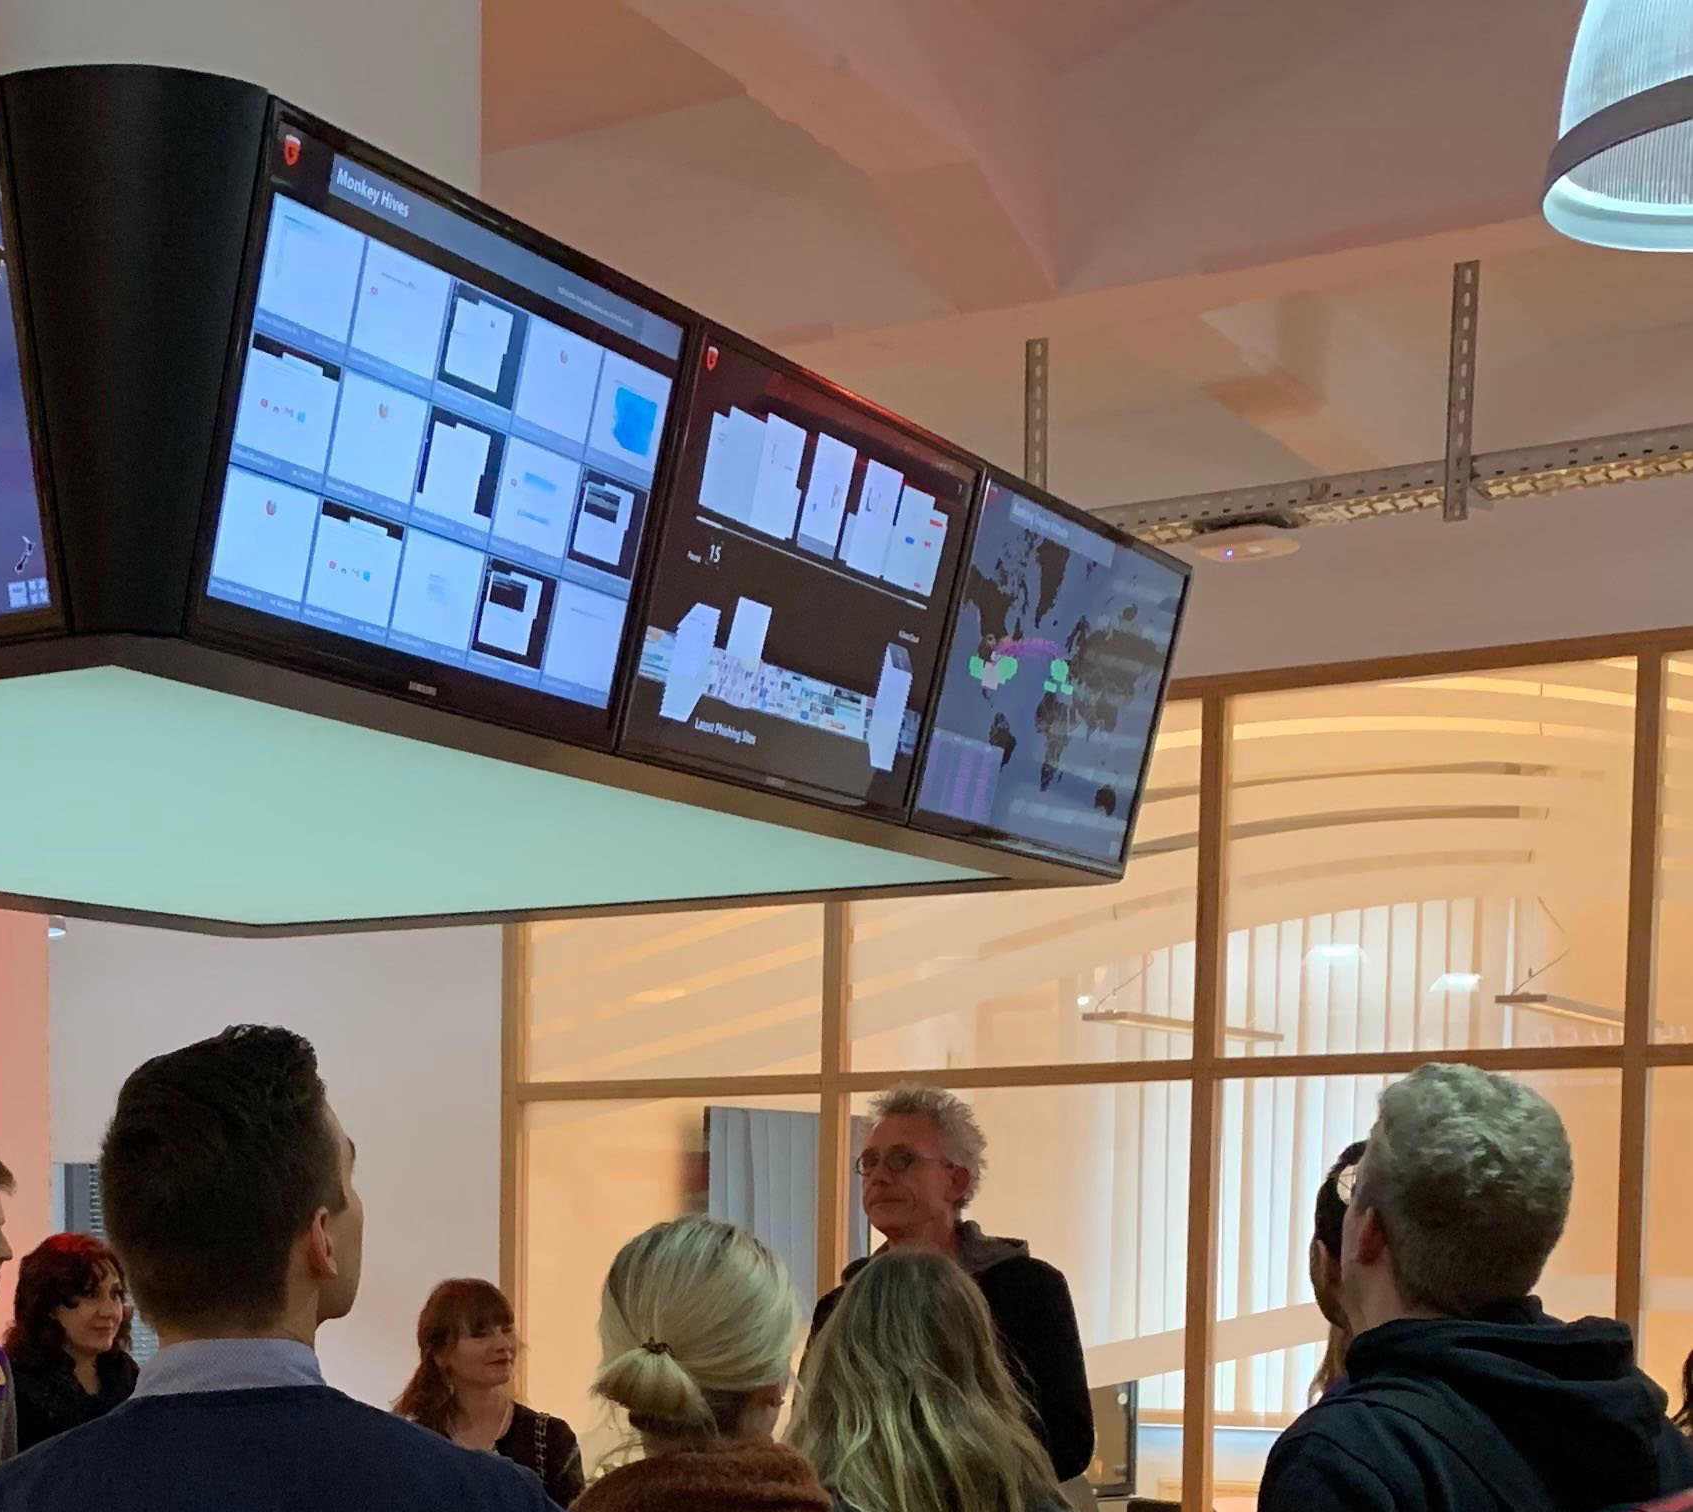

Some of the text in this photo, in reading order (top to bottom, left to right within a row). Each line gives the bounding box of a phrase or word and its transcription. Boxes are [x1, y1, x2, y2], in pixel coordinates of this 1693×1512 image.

[336, 167, 410, 218] Monkey Hives
[709, 544, 722, 563] 15
